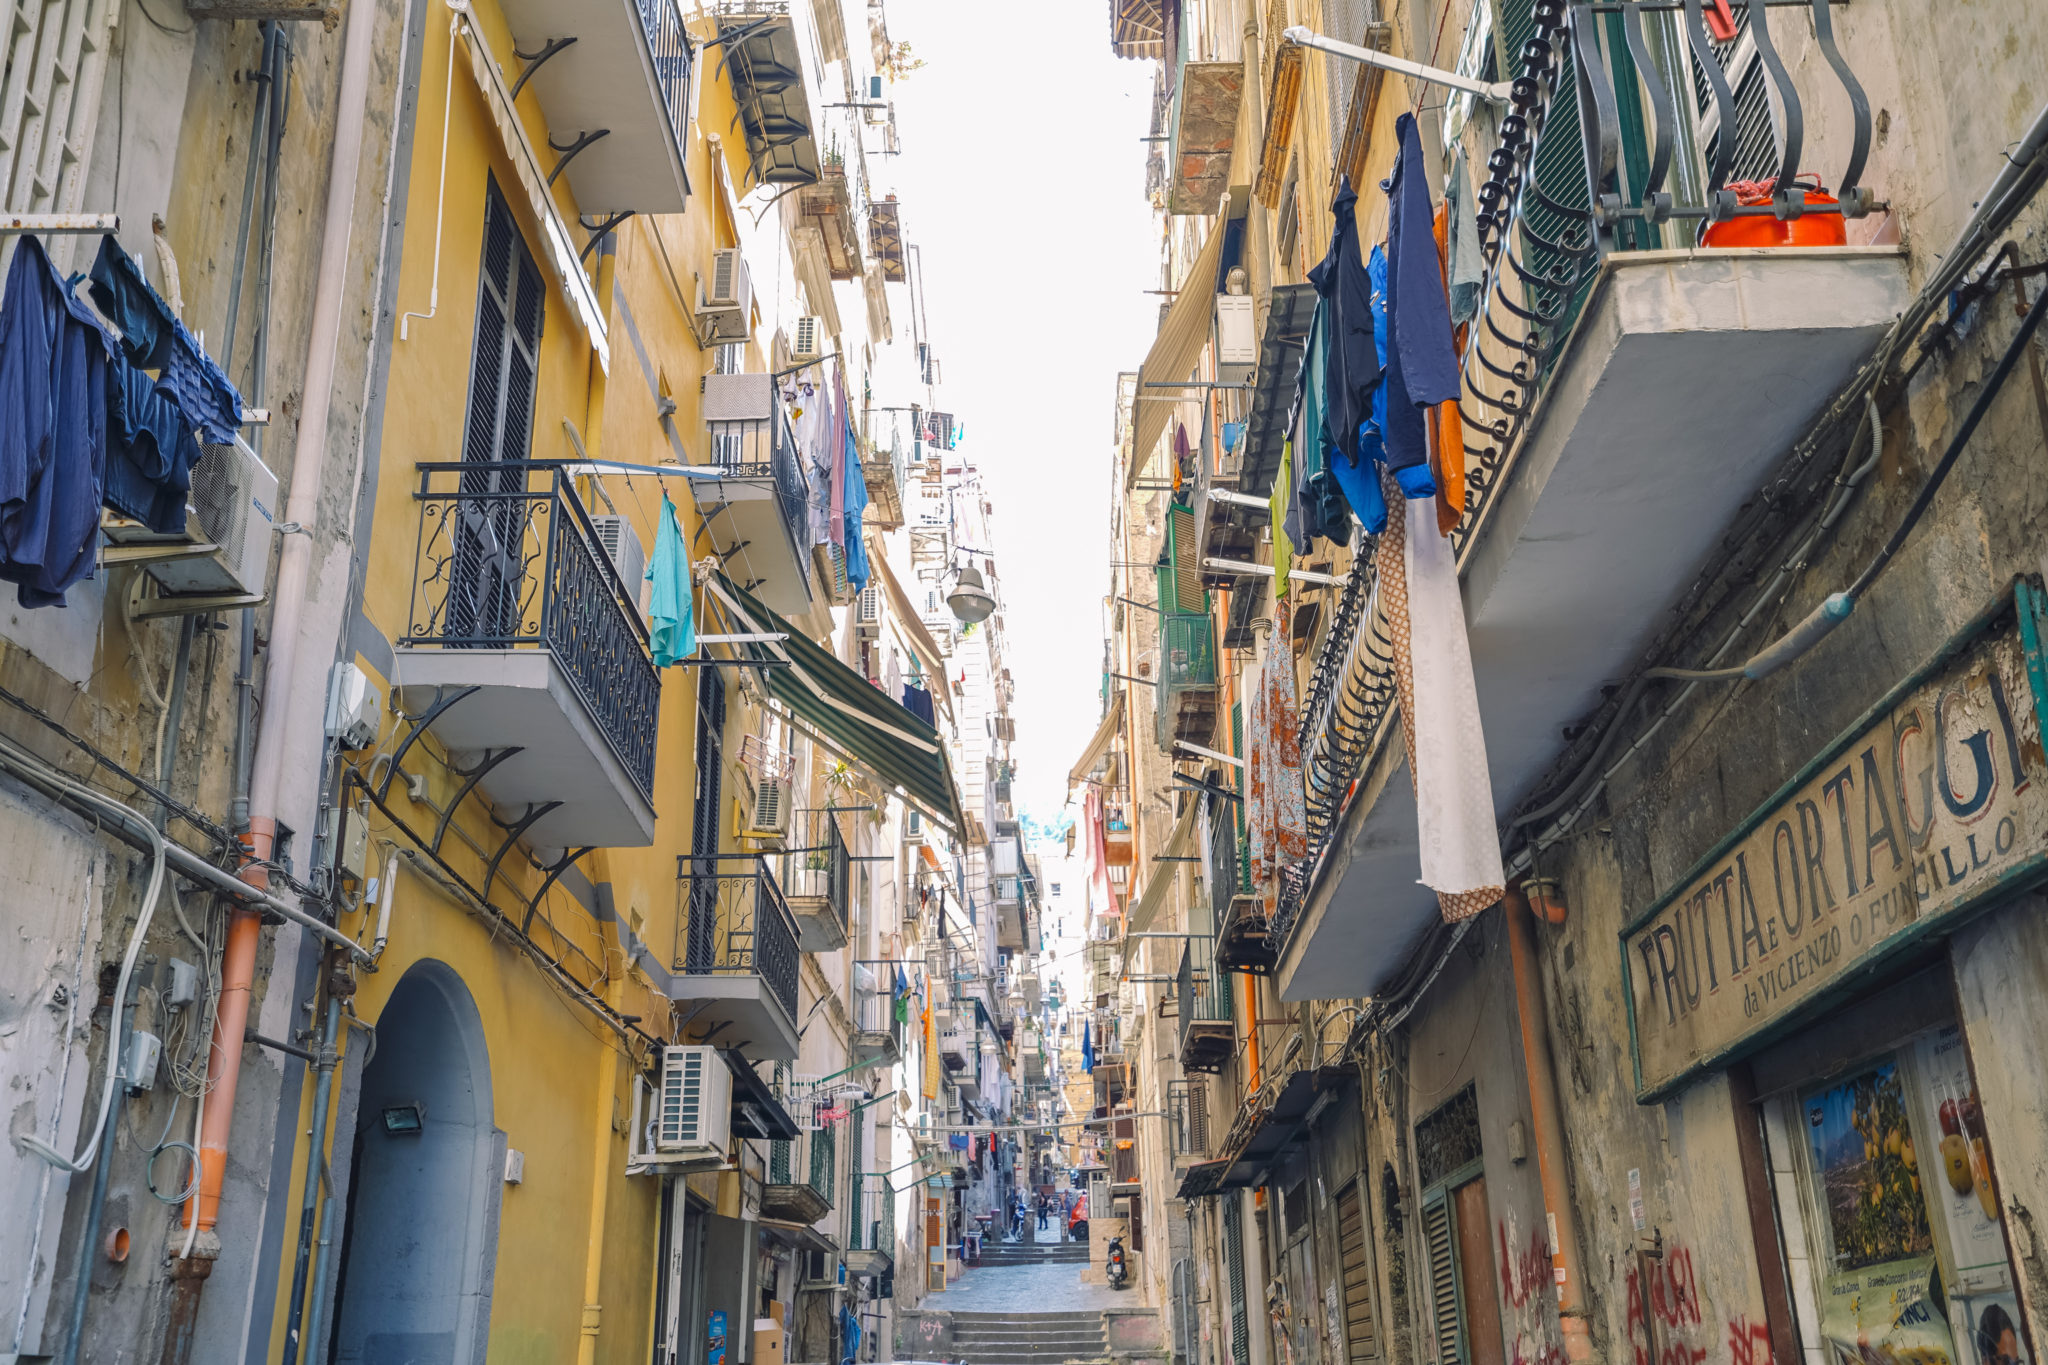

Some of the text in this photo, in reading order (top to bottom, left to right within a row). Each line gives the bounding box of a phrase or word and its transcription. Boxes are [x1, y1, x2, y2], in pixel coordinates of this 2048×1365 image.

[1638, 673, 2031, 1026] FRUTTA E ORTAGGI
[1744, 984, 1760, 1018] da
[1758, 926, 1842, 1005] VICIENZO
